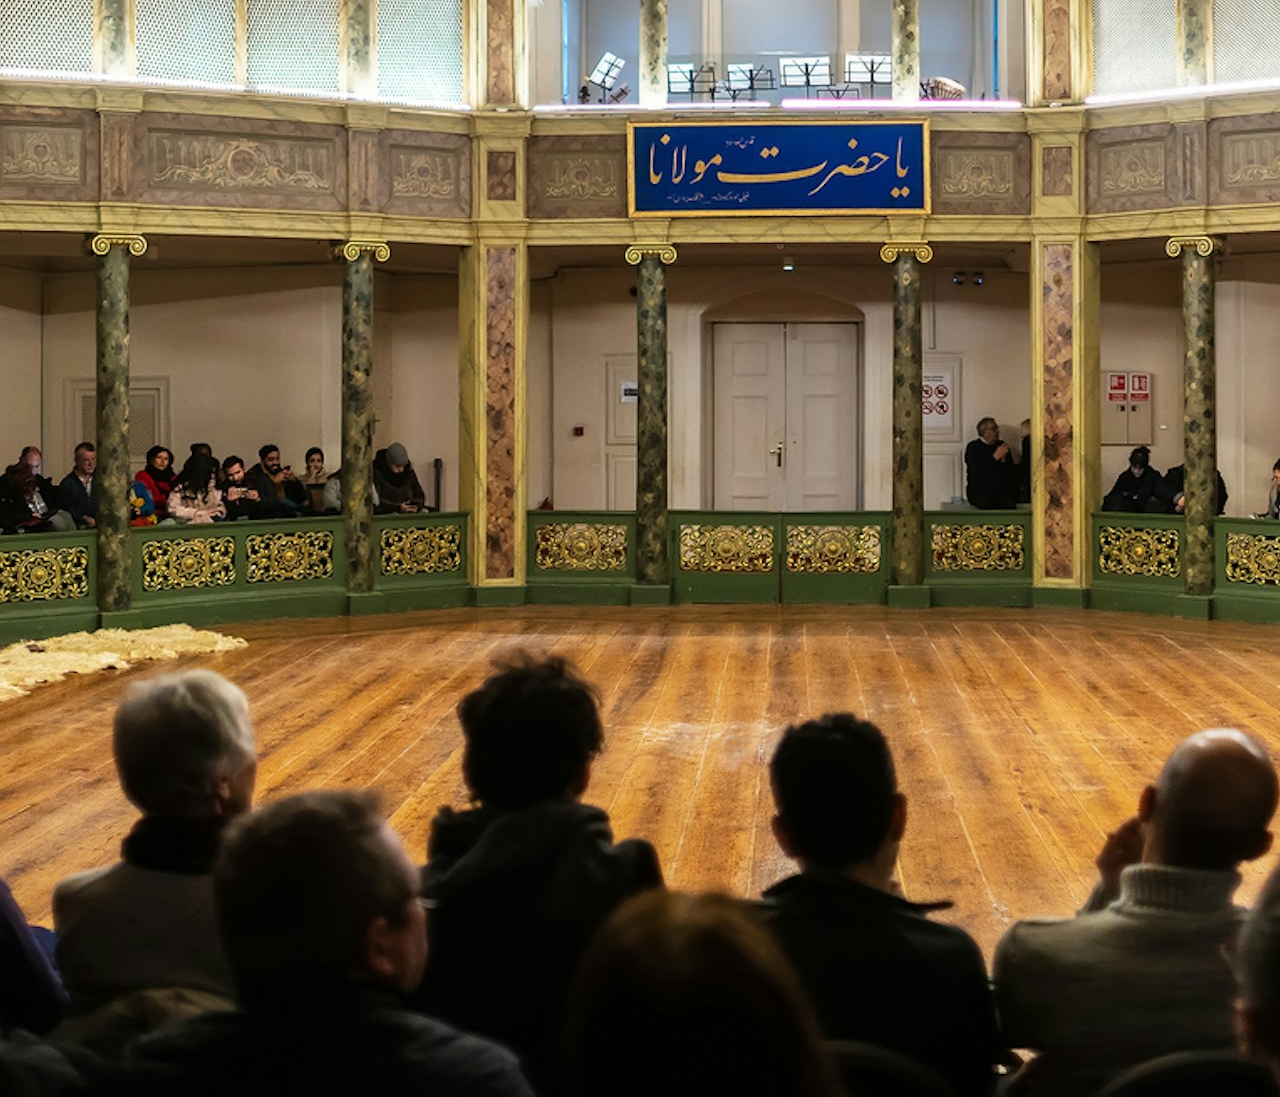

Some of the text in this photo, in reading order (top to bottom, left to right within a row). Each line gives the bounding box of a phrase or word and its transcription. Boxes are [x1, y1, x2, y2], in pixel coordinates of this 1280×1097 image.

[650, 134, 911, 197] يا حضرت مولانا
